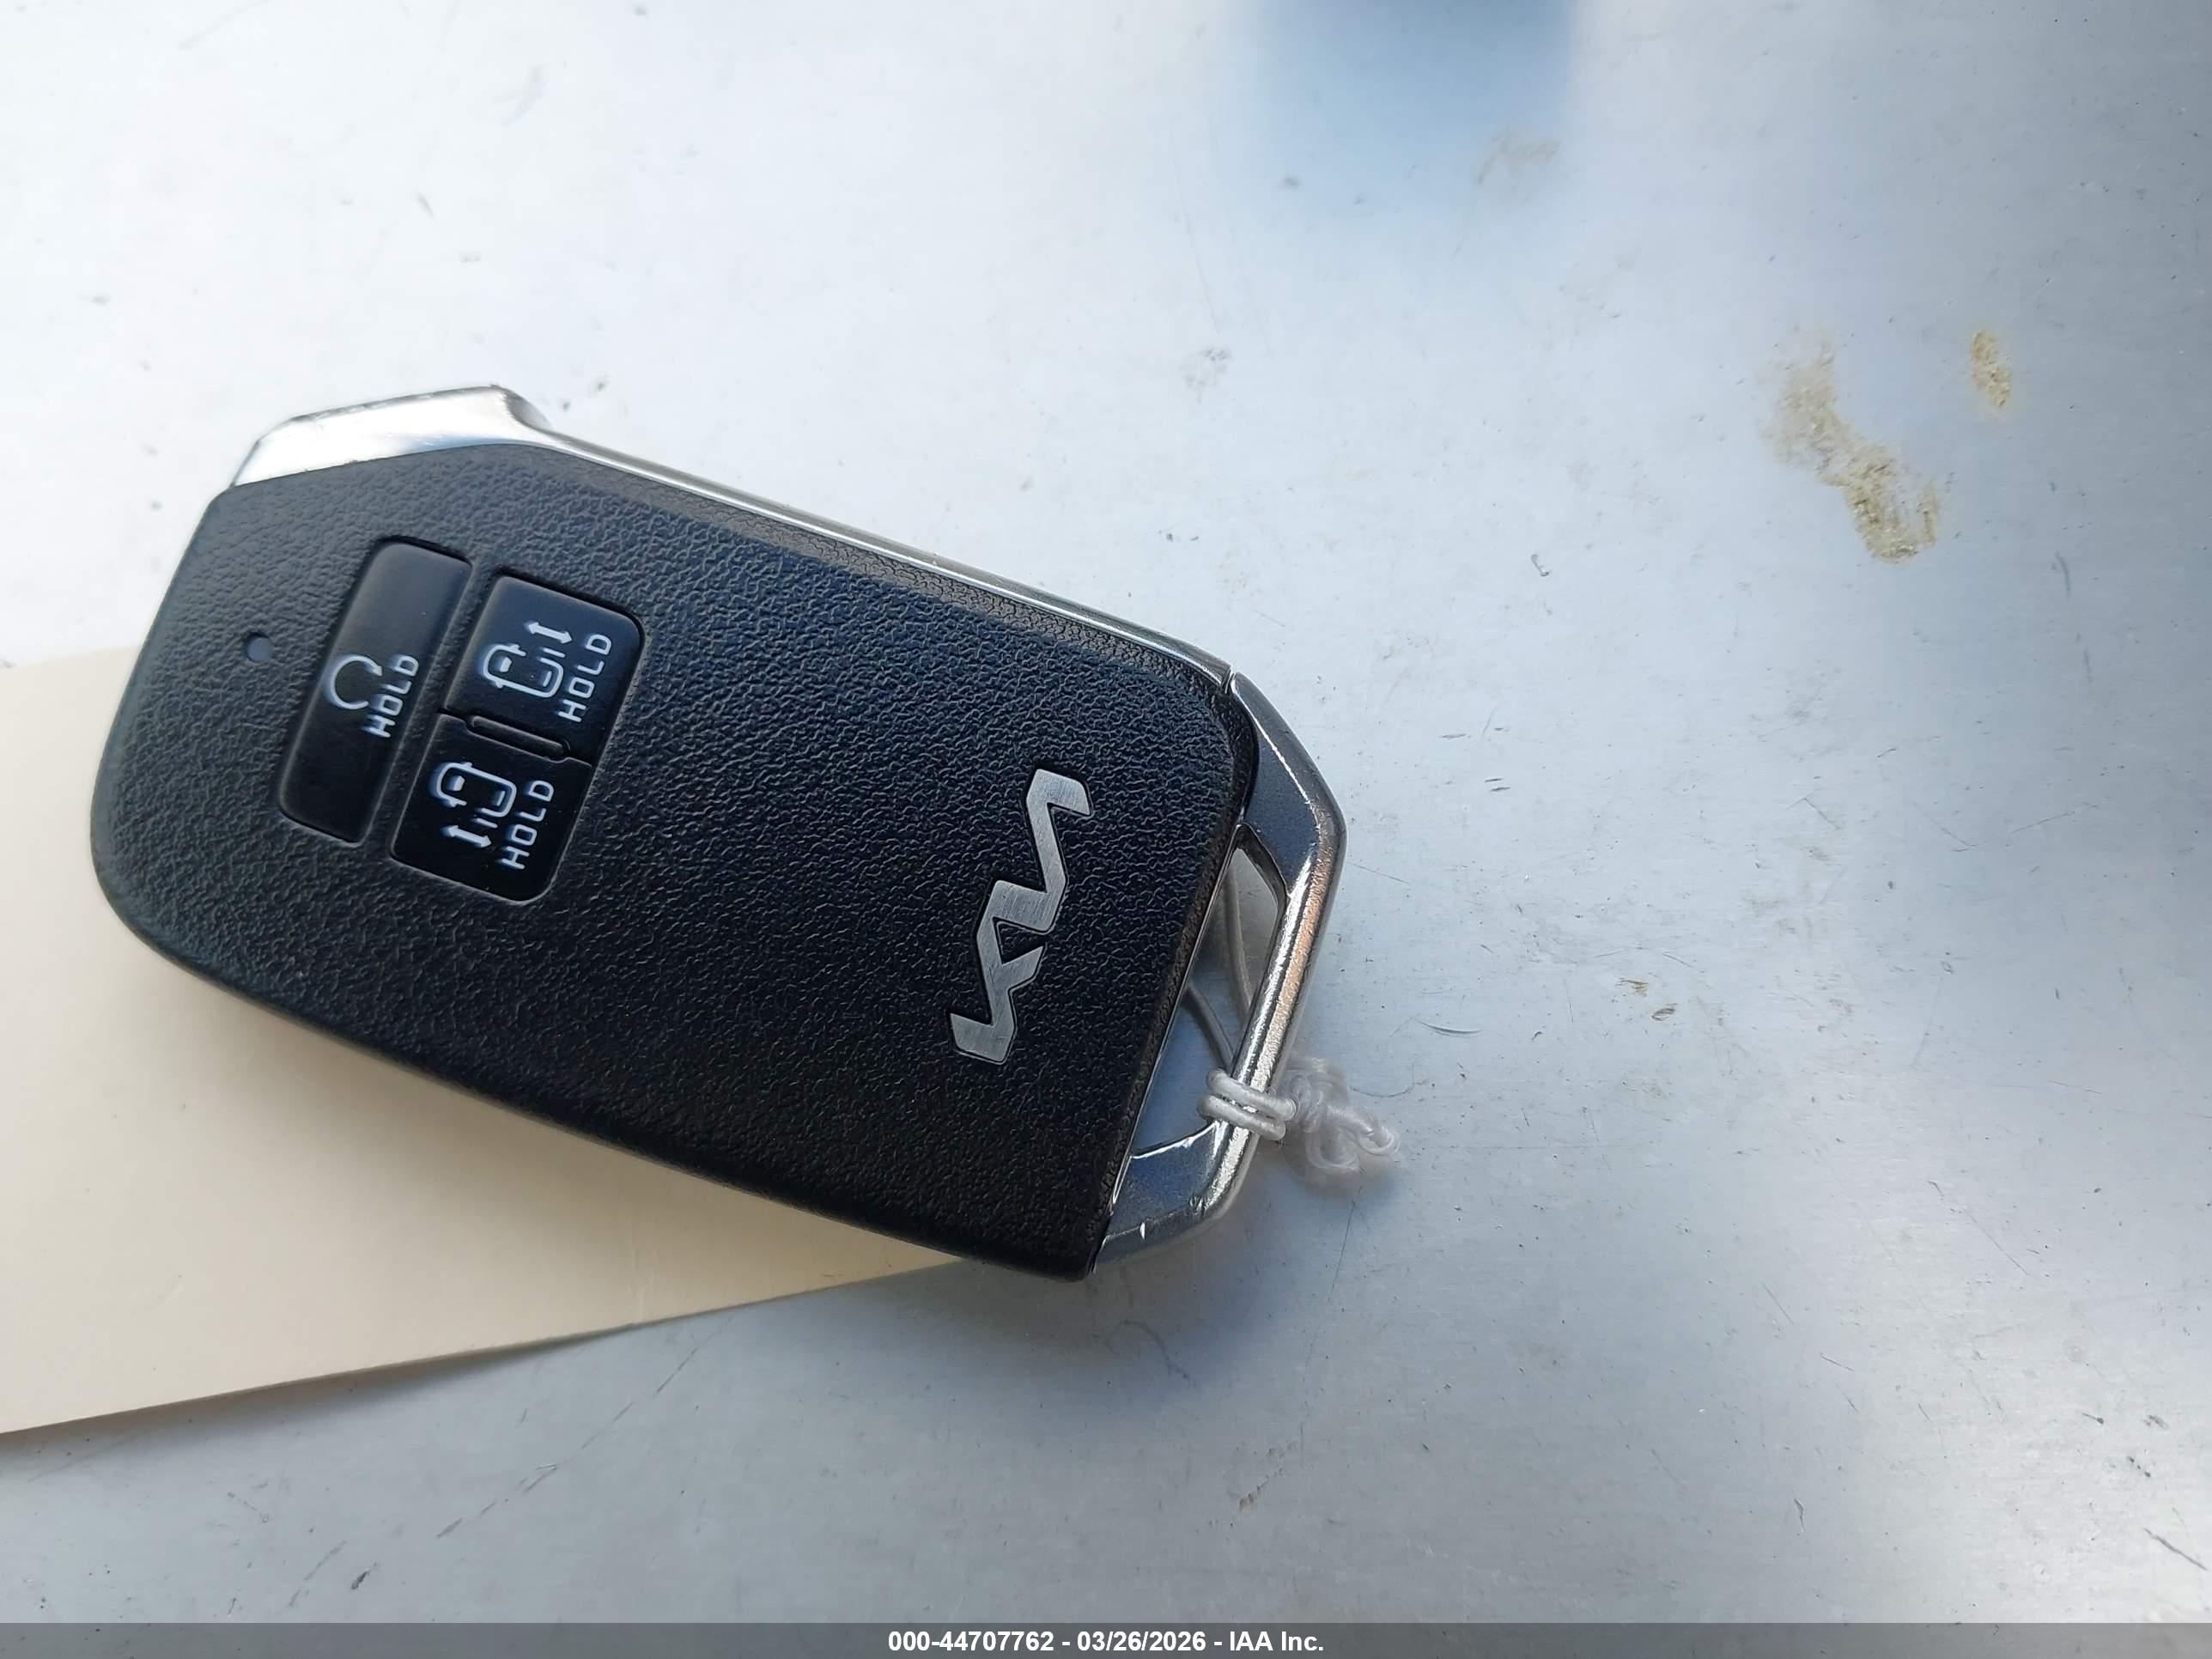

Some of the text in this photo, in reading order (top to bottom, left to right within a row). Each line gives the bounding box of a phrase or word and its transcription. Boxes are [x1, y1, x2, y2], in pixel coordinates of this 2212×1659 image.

[366, 654, 419, 738] HOLD
[558, 633, 612, 723] HOLD
[501, 780, 555, 870] HOLD
